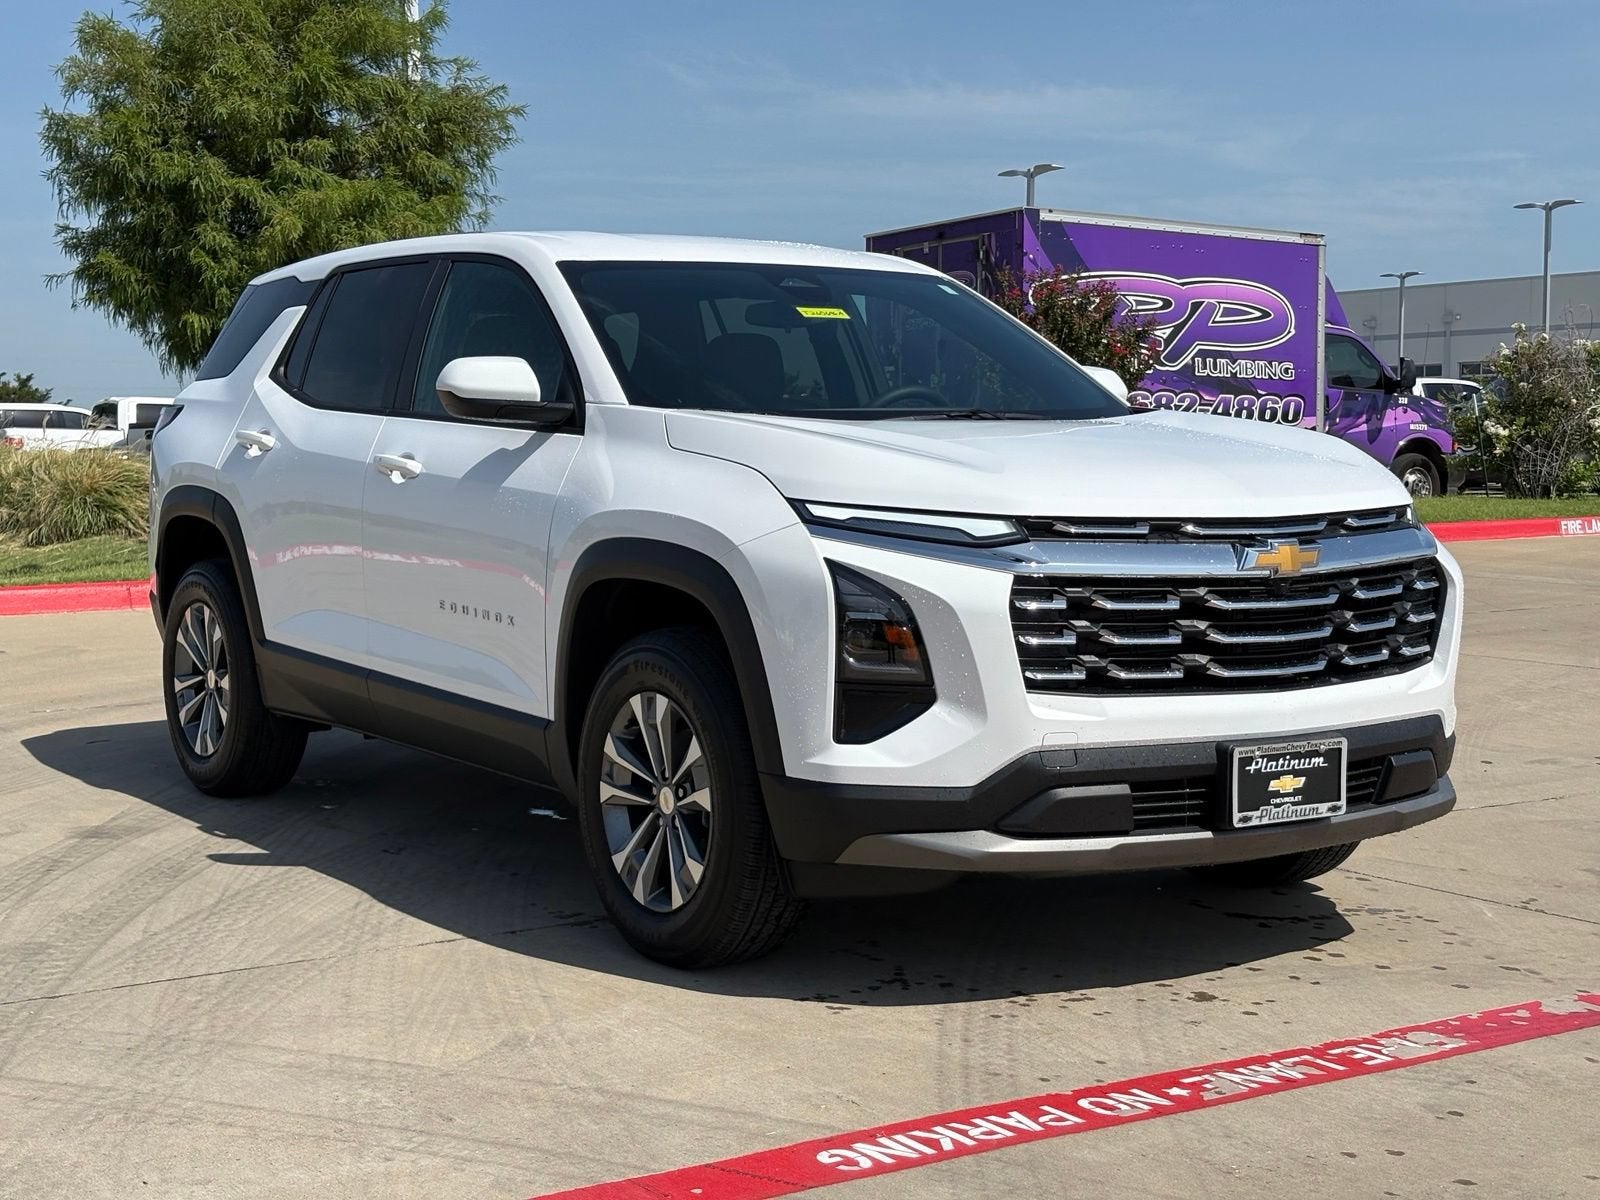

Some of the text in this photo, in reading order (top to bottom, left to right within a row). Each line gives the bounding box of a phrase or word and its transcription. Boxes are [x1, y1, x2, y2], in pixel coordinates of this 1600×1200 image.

[1195, 358, 1295, 380] LUMBING
[1560, 519, 1585, 535] FIRE
[439, 599, 515, 626] EQUINOX
[1245, 755, 1328, 774] Platinum
[1270, 796, 1302, 804] CHEVROLET
[1255, 803, 1324, 823] Platinum
[1077, 1088, 1176, 1117] NO
[815, 1105, 1085, 1171] PARKING
